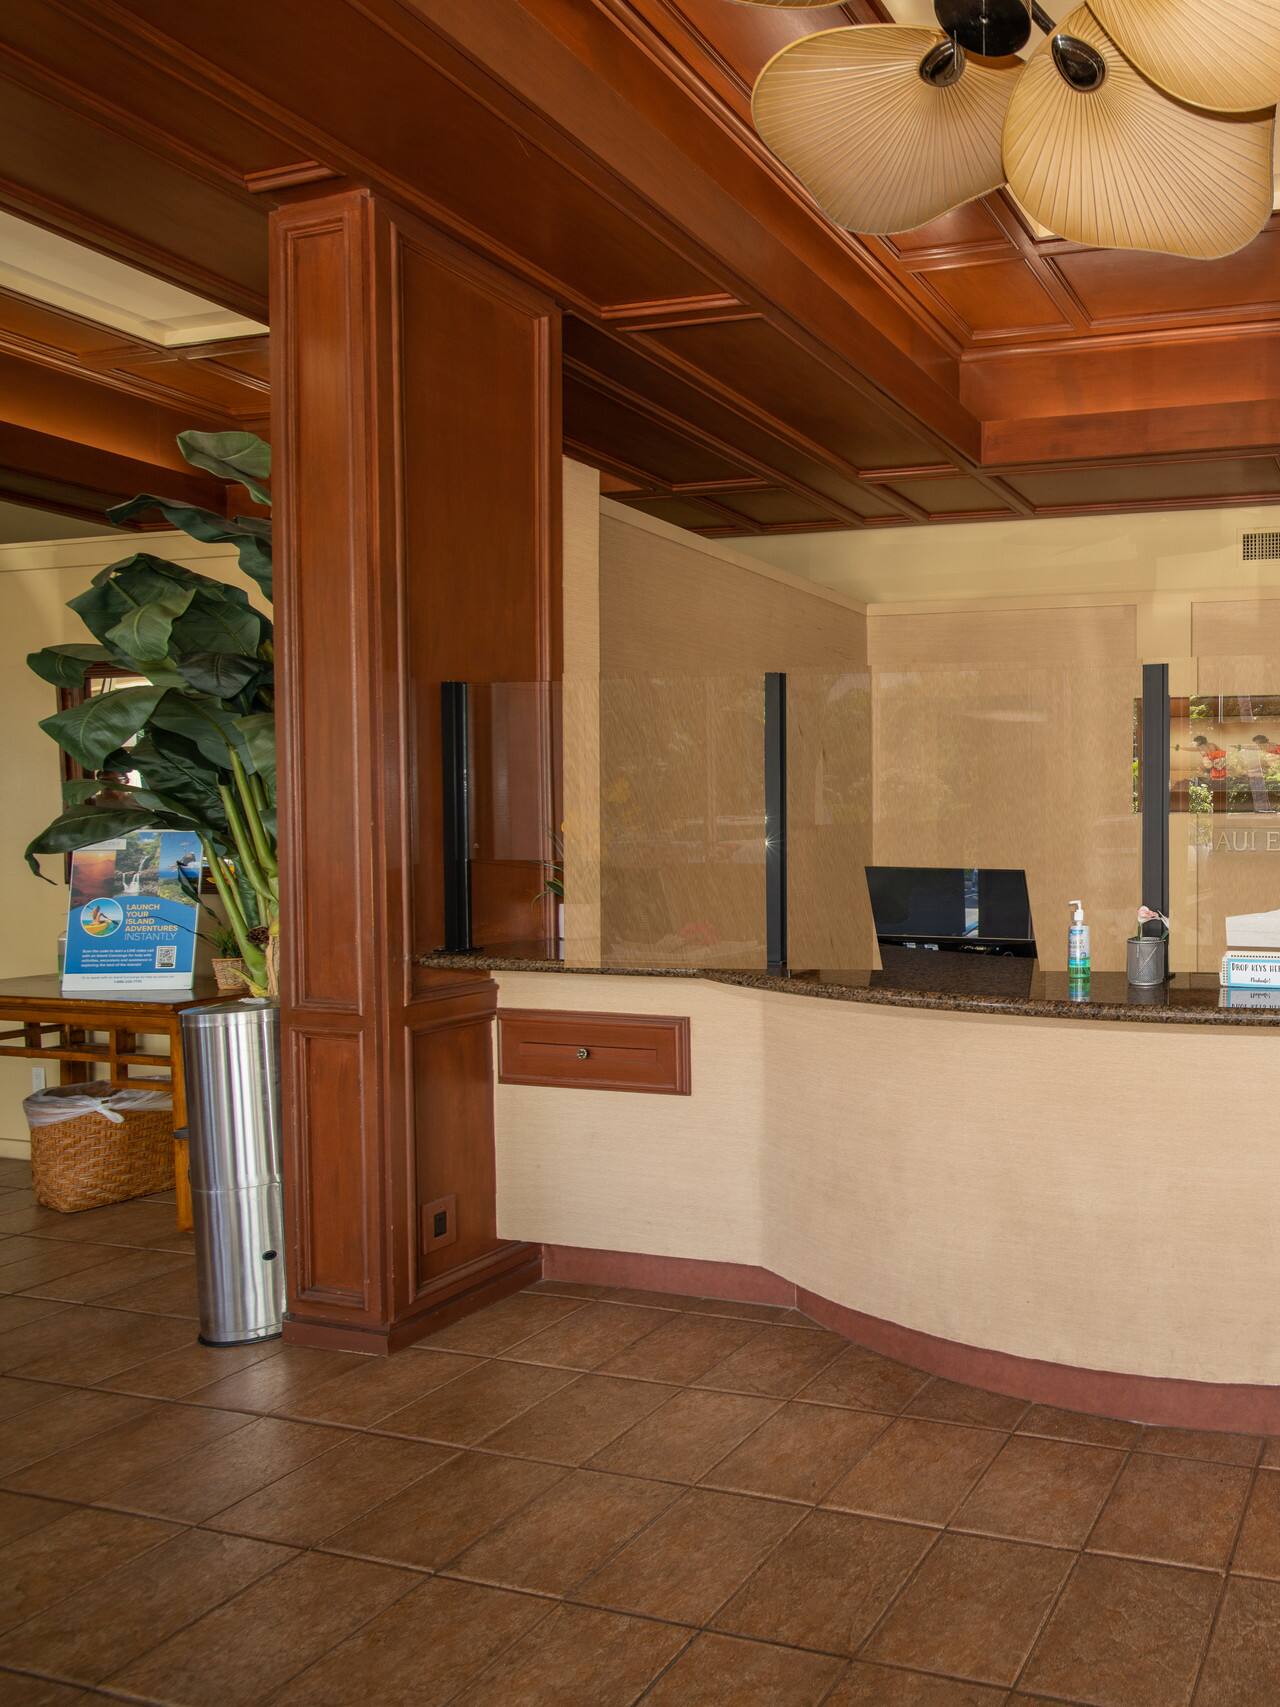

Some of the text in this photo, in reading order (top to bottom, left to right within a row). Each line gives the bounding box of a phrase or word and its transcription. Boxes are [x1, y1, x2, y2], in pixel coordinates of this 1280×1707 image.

[124, 932, 177, 941] INSTANTLY
[1231, 962, 1249, 973] DROP
[1251, 963, 1267, 973] KEYS
